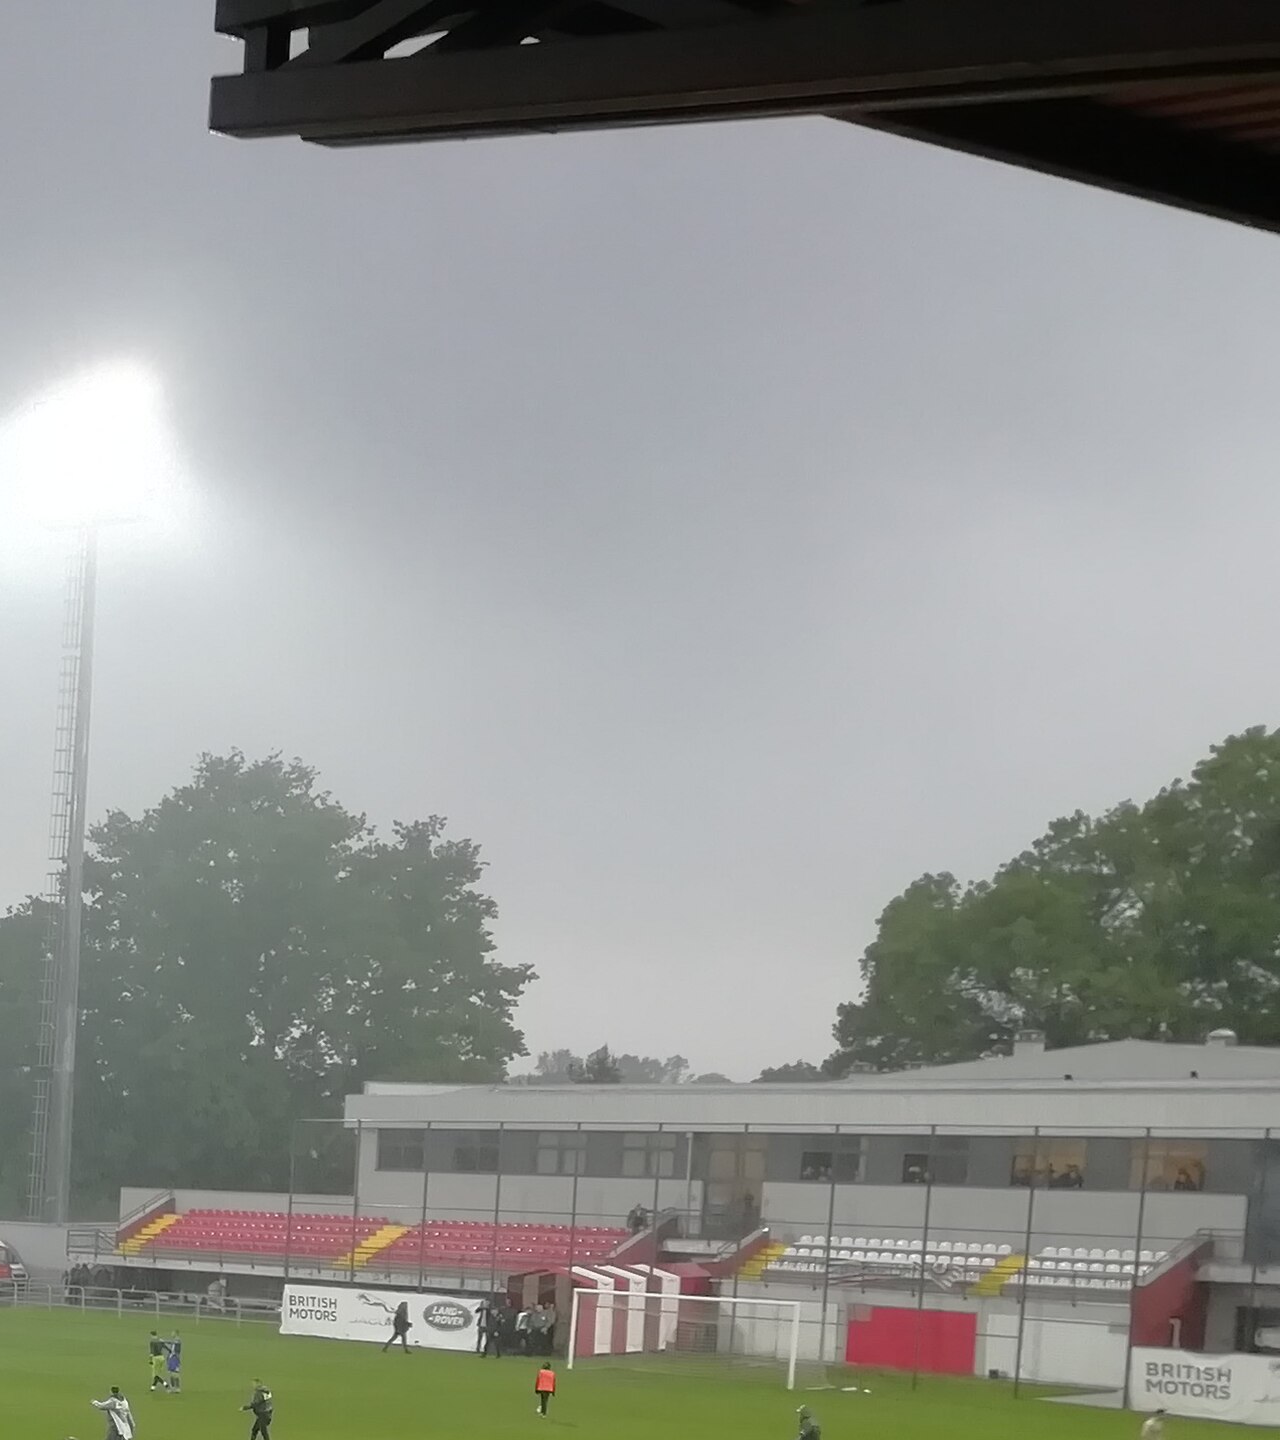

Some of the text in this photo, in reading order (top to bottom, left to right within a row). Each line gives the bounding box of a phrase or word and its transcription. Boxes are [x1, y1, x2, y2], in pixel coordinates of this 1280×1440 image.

[289, 1295, 337, 1309] BRITISH
[289, 1308, 337, 1322] MOTORS
[1145, 1361, 1232, 1383] BRITISH
[1145, 1378, 1231, 1400] MOTORS
